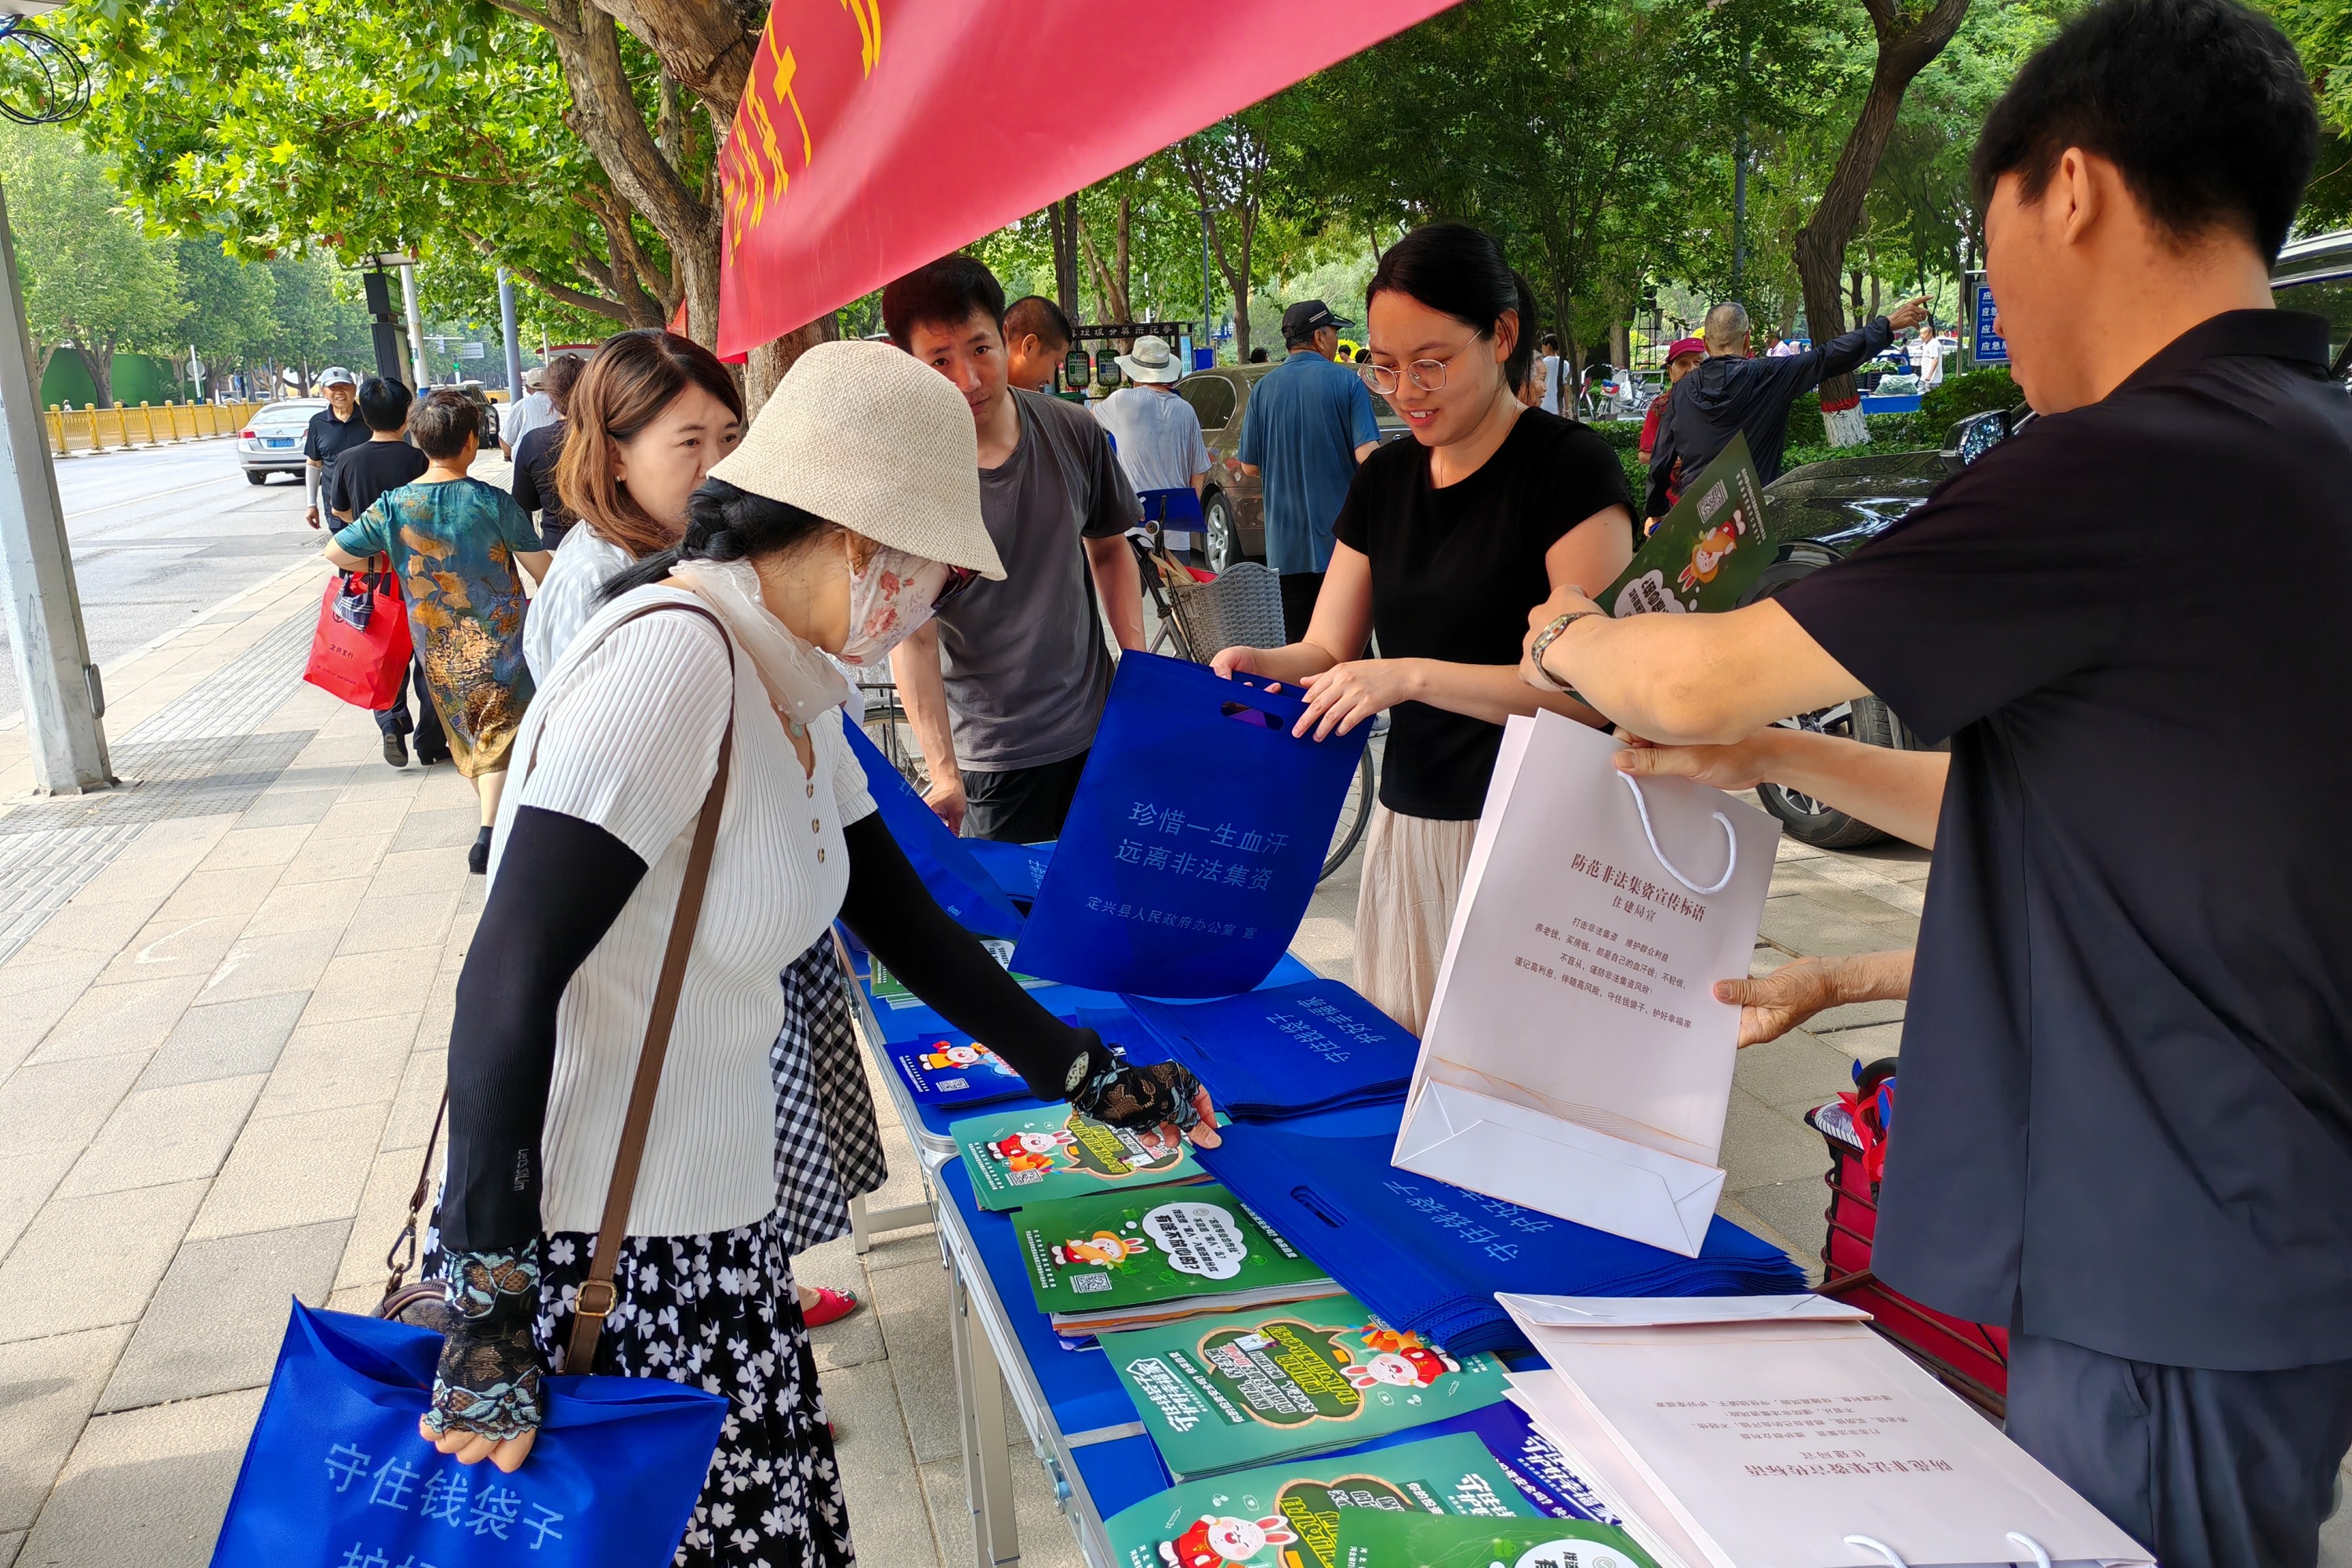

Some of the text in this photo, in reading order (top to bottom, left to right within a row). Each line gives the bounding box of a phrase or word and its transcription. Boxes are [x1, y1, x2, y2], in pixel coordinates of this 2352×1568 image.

[1128, 802, 1289, 855] 珍惜一生血汗
[1114, 838, 1273, 891] 远离非法集资
[1570, 853, 1707, 922] 防范非法集资宣传标语
[1085, 897, 1258, 939] 定兴县人民政府办公室 宣
[1612, 895, 1657, 923] 住建局宣
[1572, 916, 1670, 963] 打击非法集资 维护群众利益
[1265, 1013, 1351, 1063] 守住钱袋子
[1297, 996, 1387, 1044] 护好幸福家
[1154, 1214, 1200, 1269] 有啥不放心的？
[1382, 1181, 1519, 1261] 守住钱袋子
[1137, 1361, 1200, 1416] 护好幸福家
[1275, 1354, 1328, 1394] 他们真的
[1132, 1375, 1200, 1432] 守住钱袋子
[1744, 1459, 1954, 1477] 防范非法集资宣传标语
[1798, 1449, 1865, 1459] 住建局宣
[325, 1443, 564, 1550] 守住钱袋子
